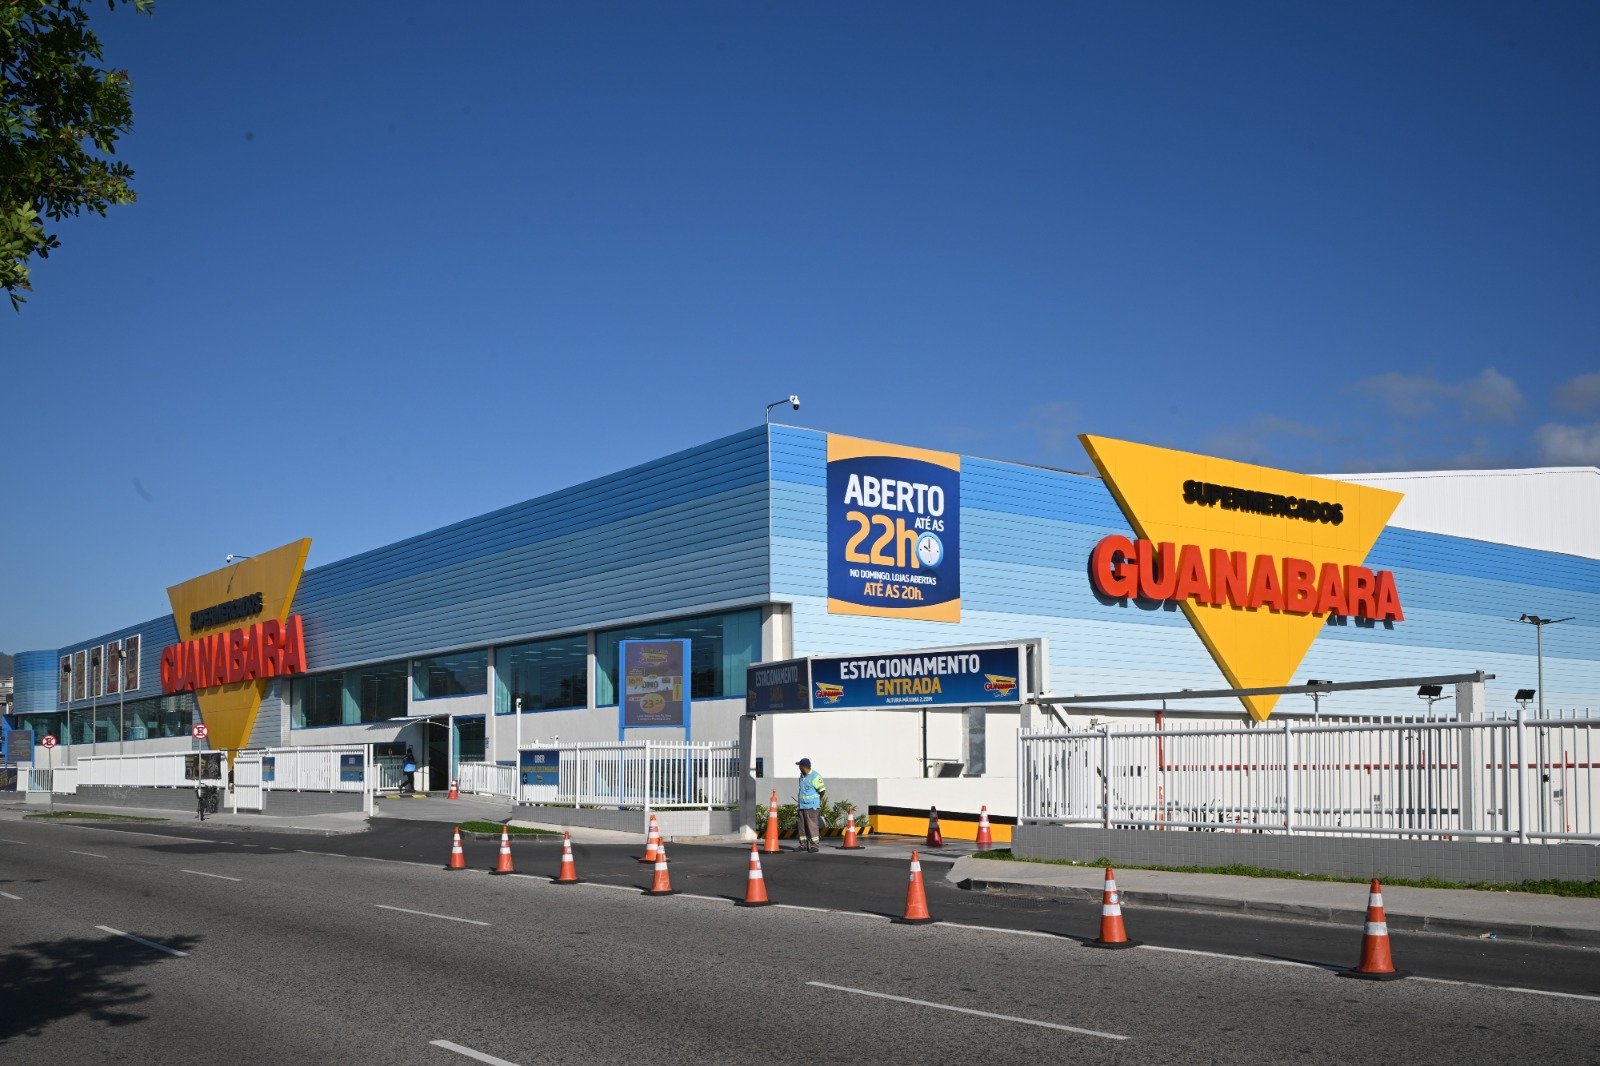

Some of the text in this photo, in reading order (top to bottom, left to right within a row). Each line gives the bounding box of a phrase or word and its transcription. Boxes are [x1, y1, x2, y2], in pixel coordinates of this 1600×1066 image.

[844, 474, 944, 516] ABERTO
[1183, 480, 1343, 526] SUPERMERCADOS
[915, 516, 944, 532] ATÉ AS
[845, 511, 921, 568] 22h
[850, 569, 859, 578] NO
[892, 574, 909, 583] LOJAS
[910, 575, 936, 586] ABERTAS
[864, 580, 924, 600] ATÉ AS 20h.
[1092, 535, 1404, 621] GUANABARA
[160, 614, 307, 694] GUANABARA
[840, 654, 980, 680] ESTACIONAMENTO
[756, 666, 798, 687] ESTACIONAMENTO
[876, 677, 941, 696] ENTRADA
